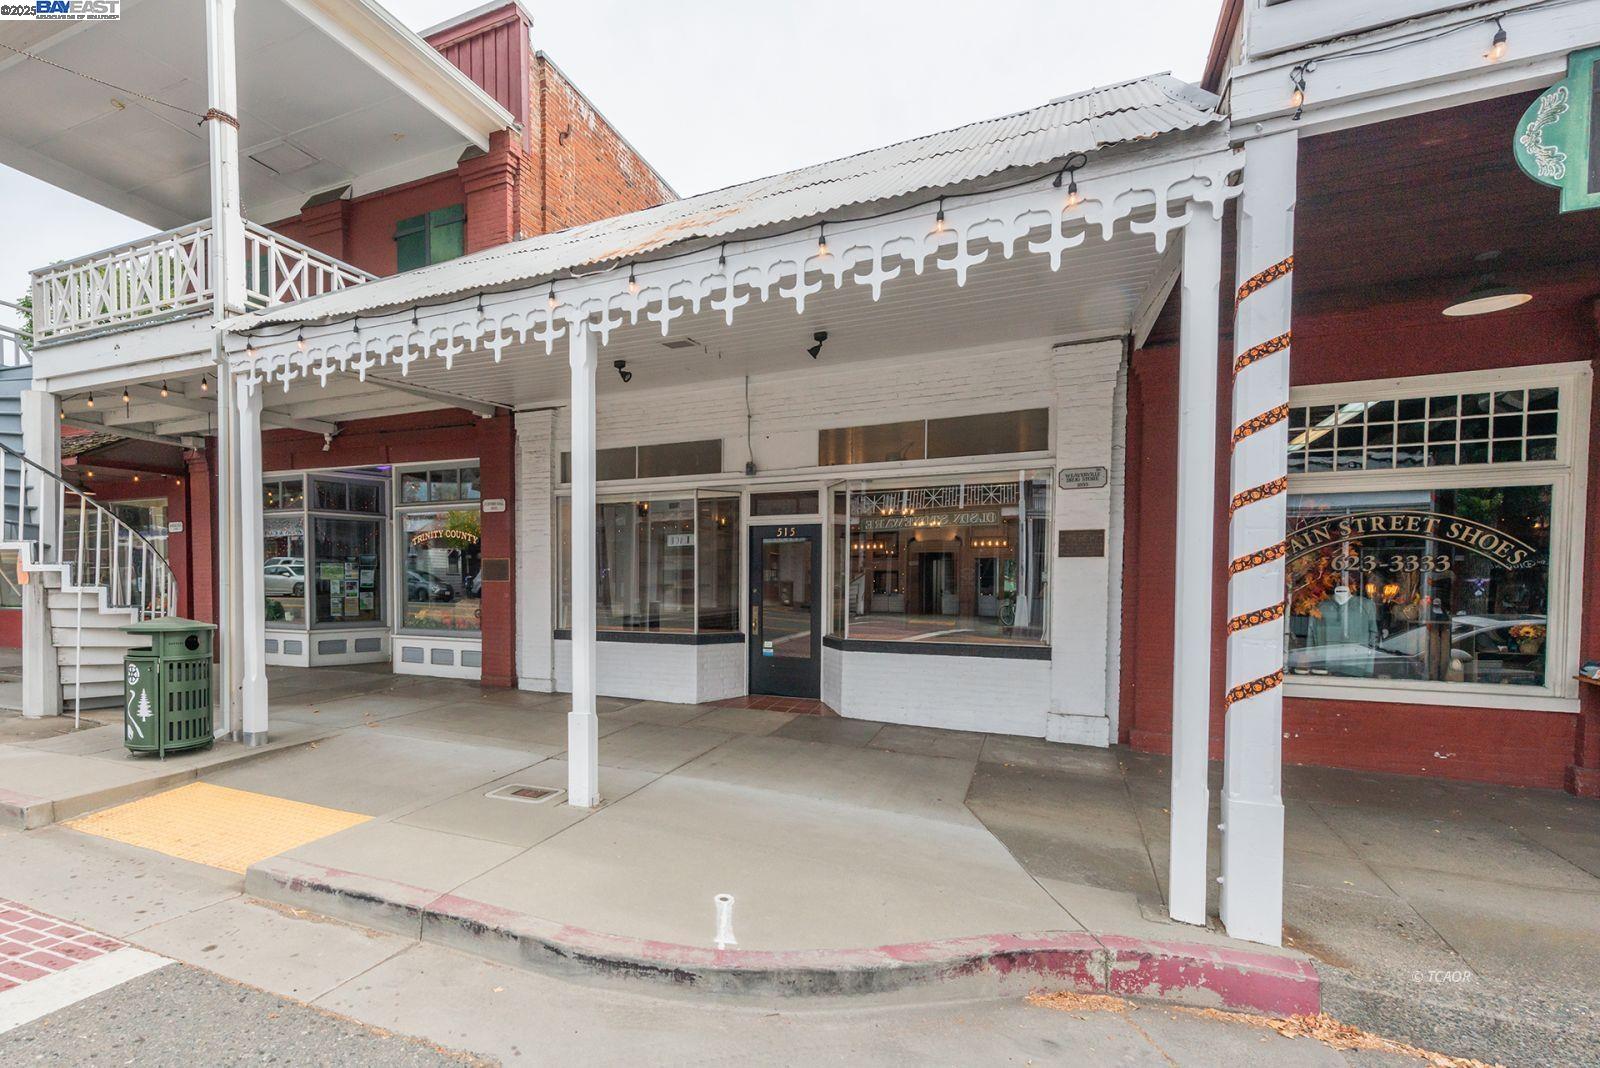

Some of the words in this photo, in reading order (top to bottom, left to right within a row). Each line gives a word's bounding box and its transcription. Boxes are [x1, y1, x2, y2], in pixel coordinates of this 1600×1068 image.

[411, 529, 444, 546] TRINITY
[445, 529, 479, 545] COUNTY
[776, 527, 796, 537] 515
[1339, 515, 1441, 539] STREET
[1446, 522, 1528, 565] SHOES
[1331, 555, 1451, 573] 623-3333
